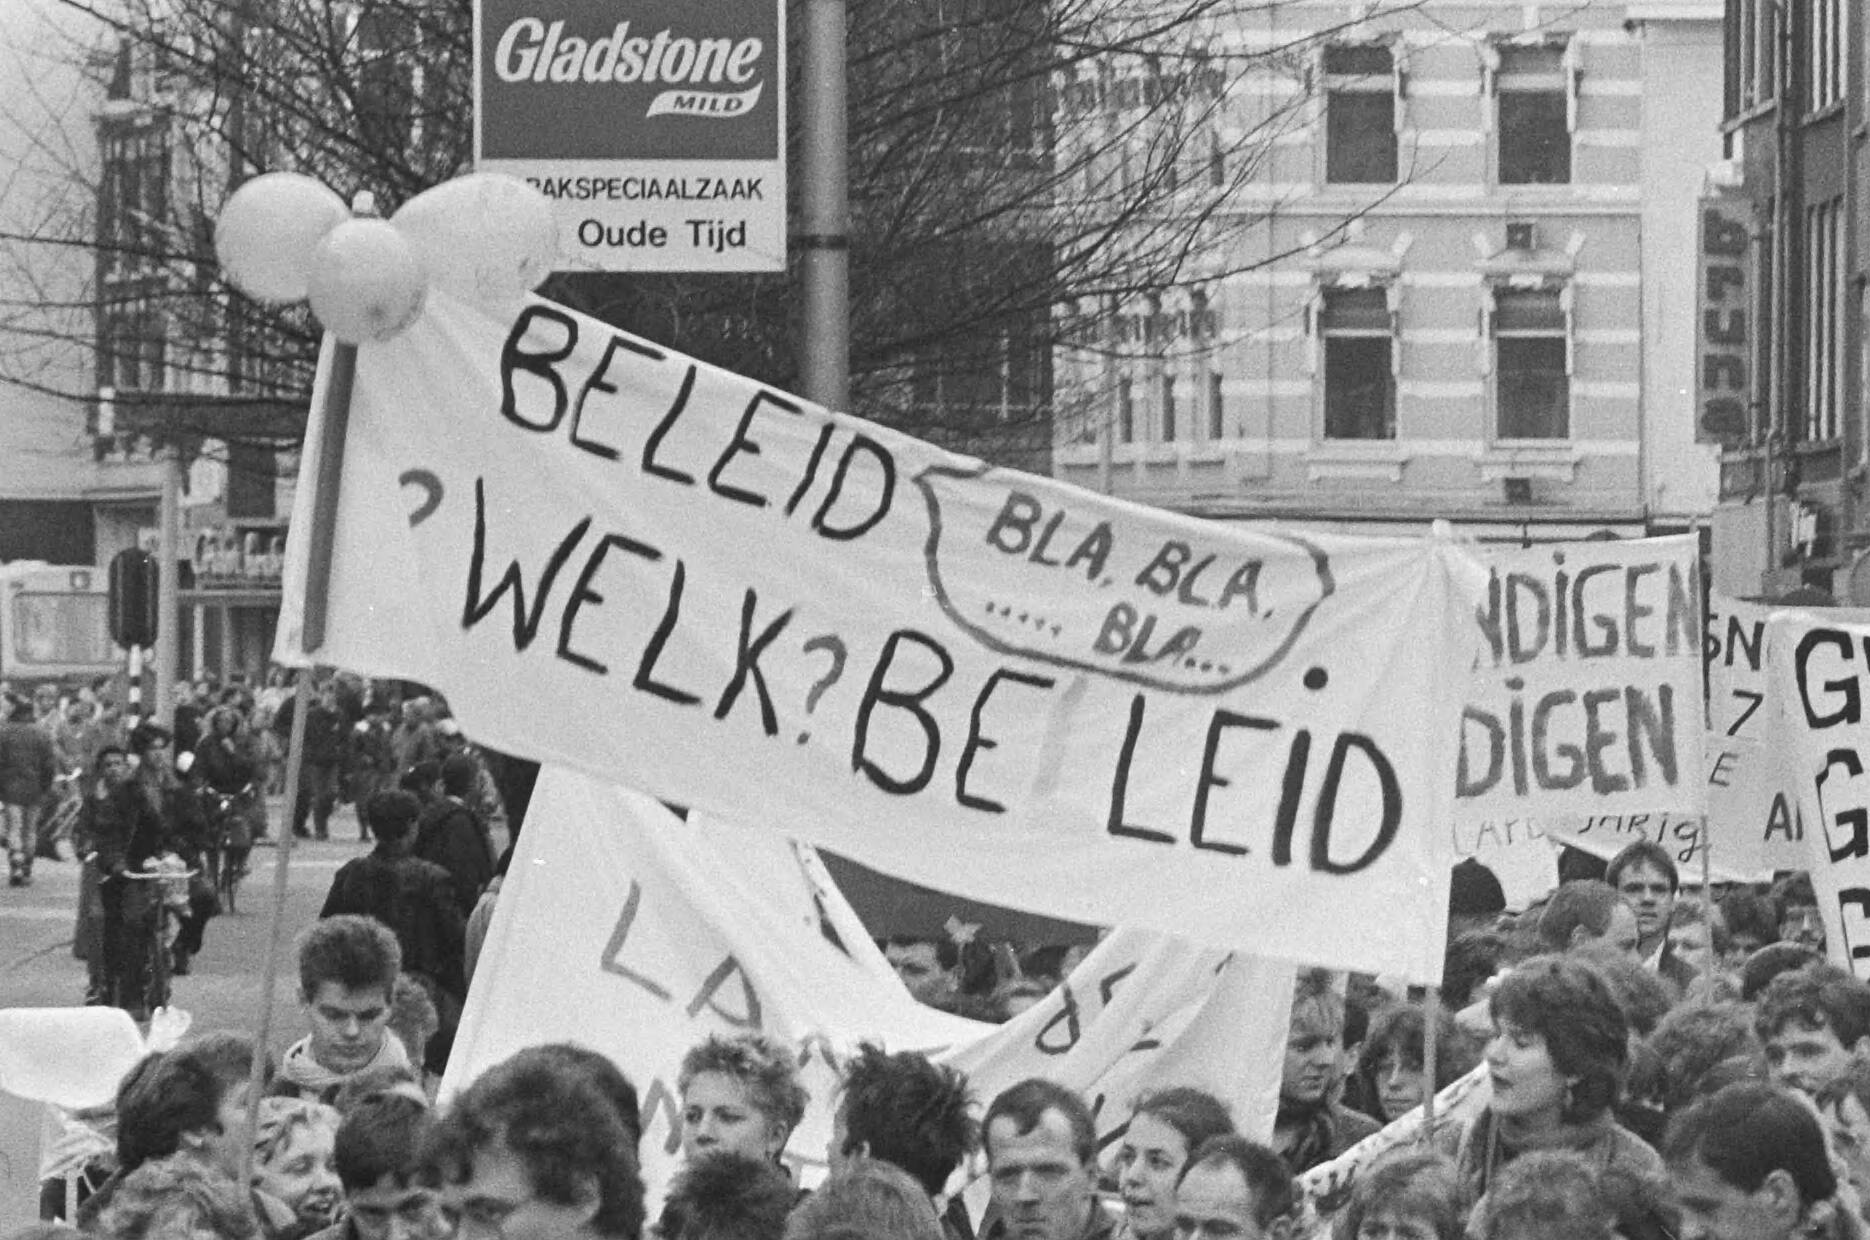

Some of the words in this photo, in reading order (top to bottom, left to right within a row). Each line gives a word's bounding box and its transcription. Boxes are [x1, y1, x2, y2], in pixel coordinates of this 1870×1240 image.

[495, 16, 763, 84] Gladstone
[674, 93, 745, 112] MILD
[578, 219, 667, 248] Oude
[686, 219, 746, 253] Tijd
[501, 304, 897, 541] BELEID
